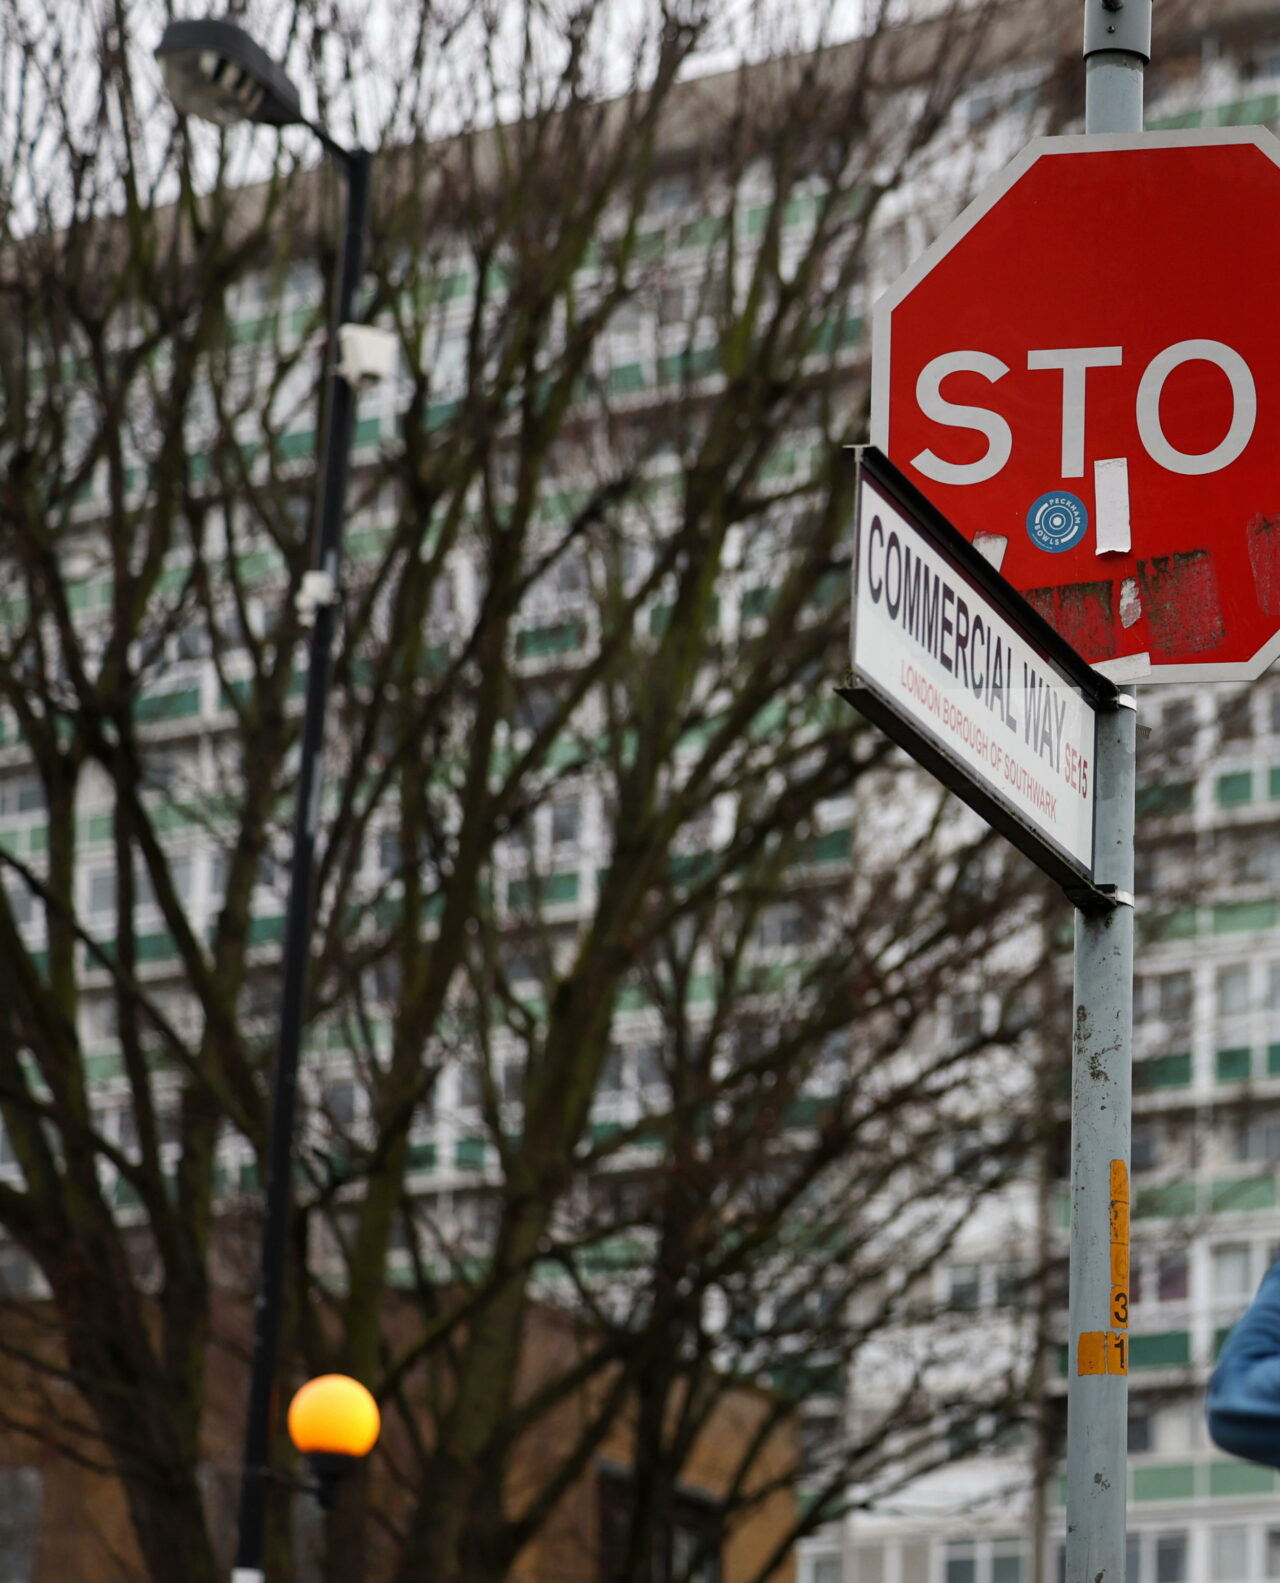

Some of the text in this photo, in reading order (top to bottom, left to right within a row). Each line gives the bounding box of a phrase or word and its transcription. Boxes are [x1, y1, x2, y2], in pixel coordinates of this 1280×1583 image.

[1049, 497, 1081, 524] PECKHAM
[1034, 525, 1060, 546] BOWLS
[868, 514, 1088, 800] COMMERCIAL WAY SE15
[900, 659, 1057, 824] LONDON BOROUGH OF SOUTHWARK
[1114, 1292, 1128, 1323] 3
[1114, 1338, 1125, 1369] 1
